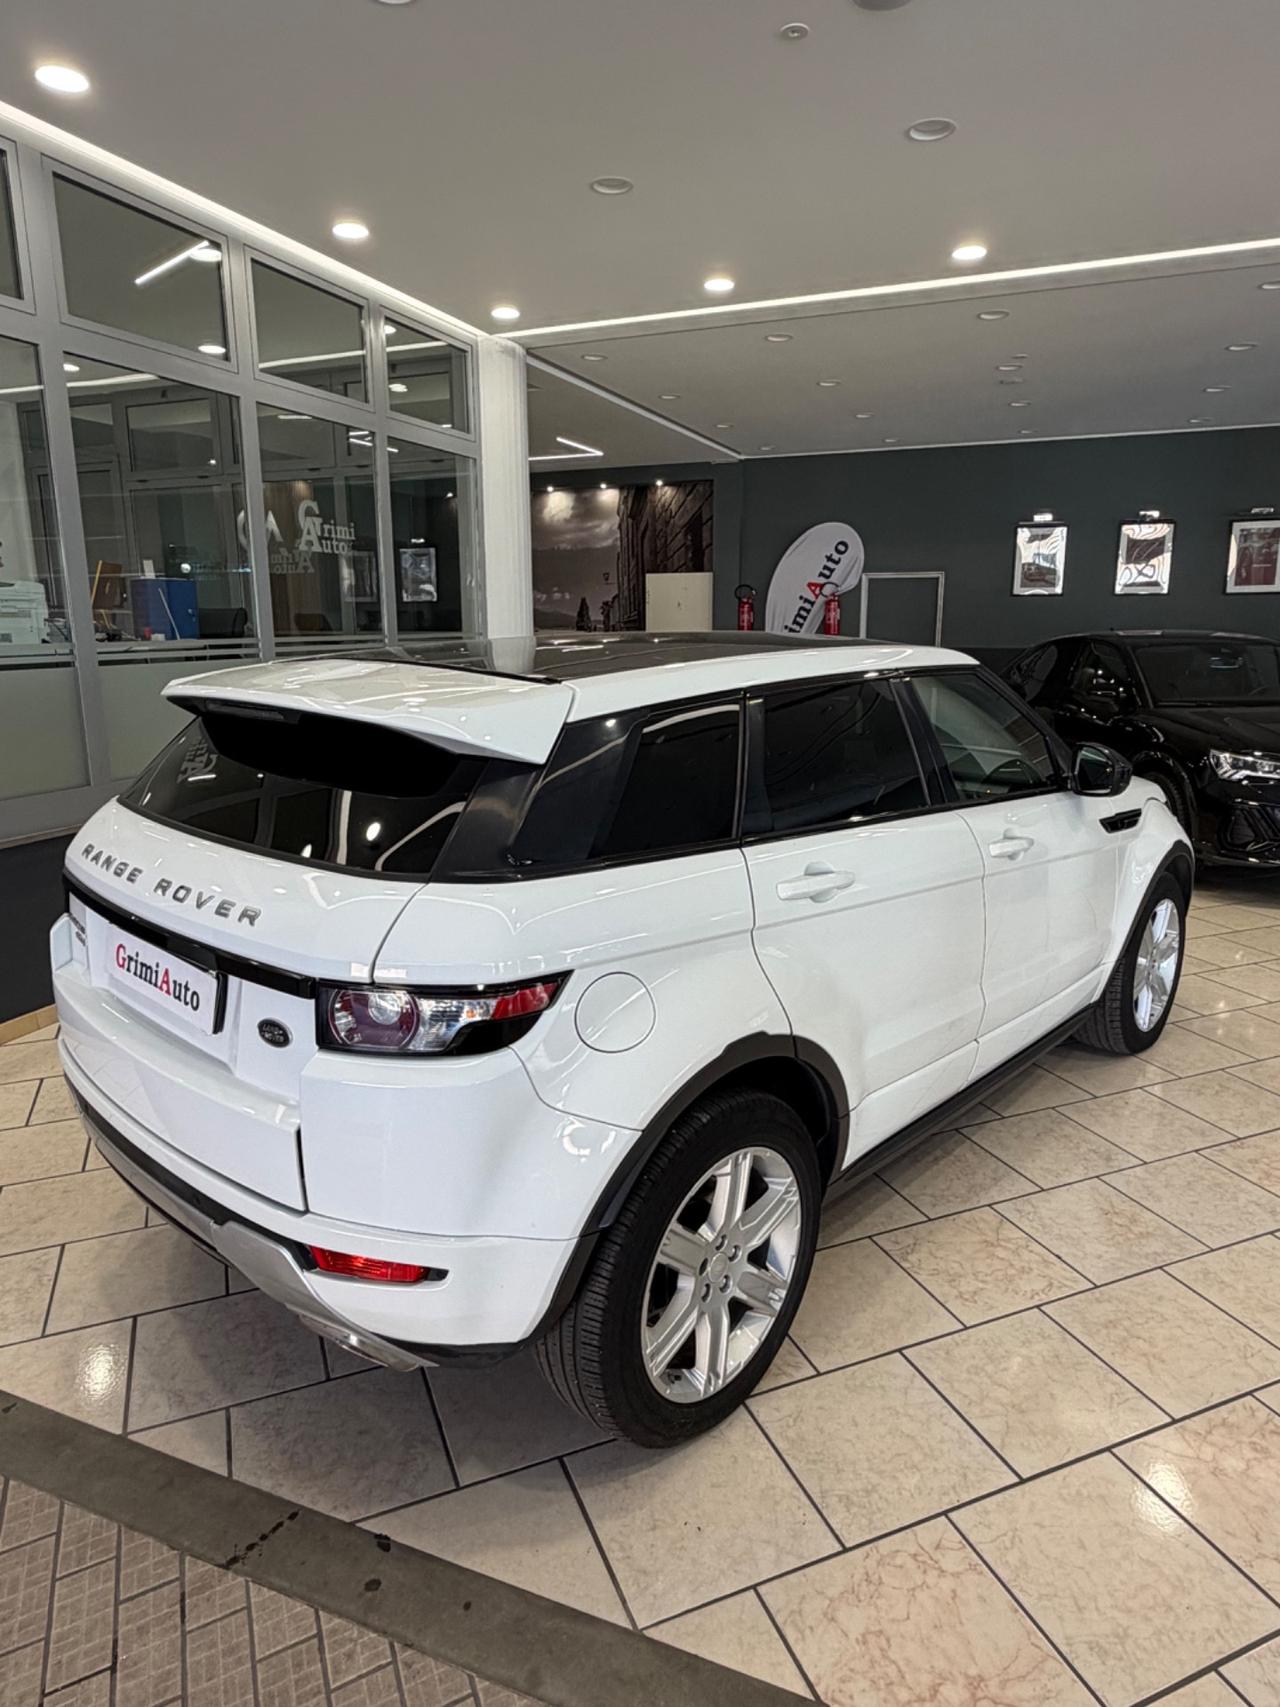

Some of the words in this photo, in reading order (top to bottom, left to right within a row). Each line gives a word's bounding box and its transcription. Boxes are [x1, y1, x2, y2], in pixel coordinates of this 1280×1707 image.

[784, 540, 849, 633] imiAuto
[81, 843, 143, 884] RANGE
[153, 878, 262, 927] ROVER
[115, 943, 200, 1012] GrimiAuto
